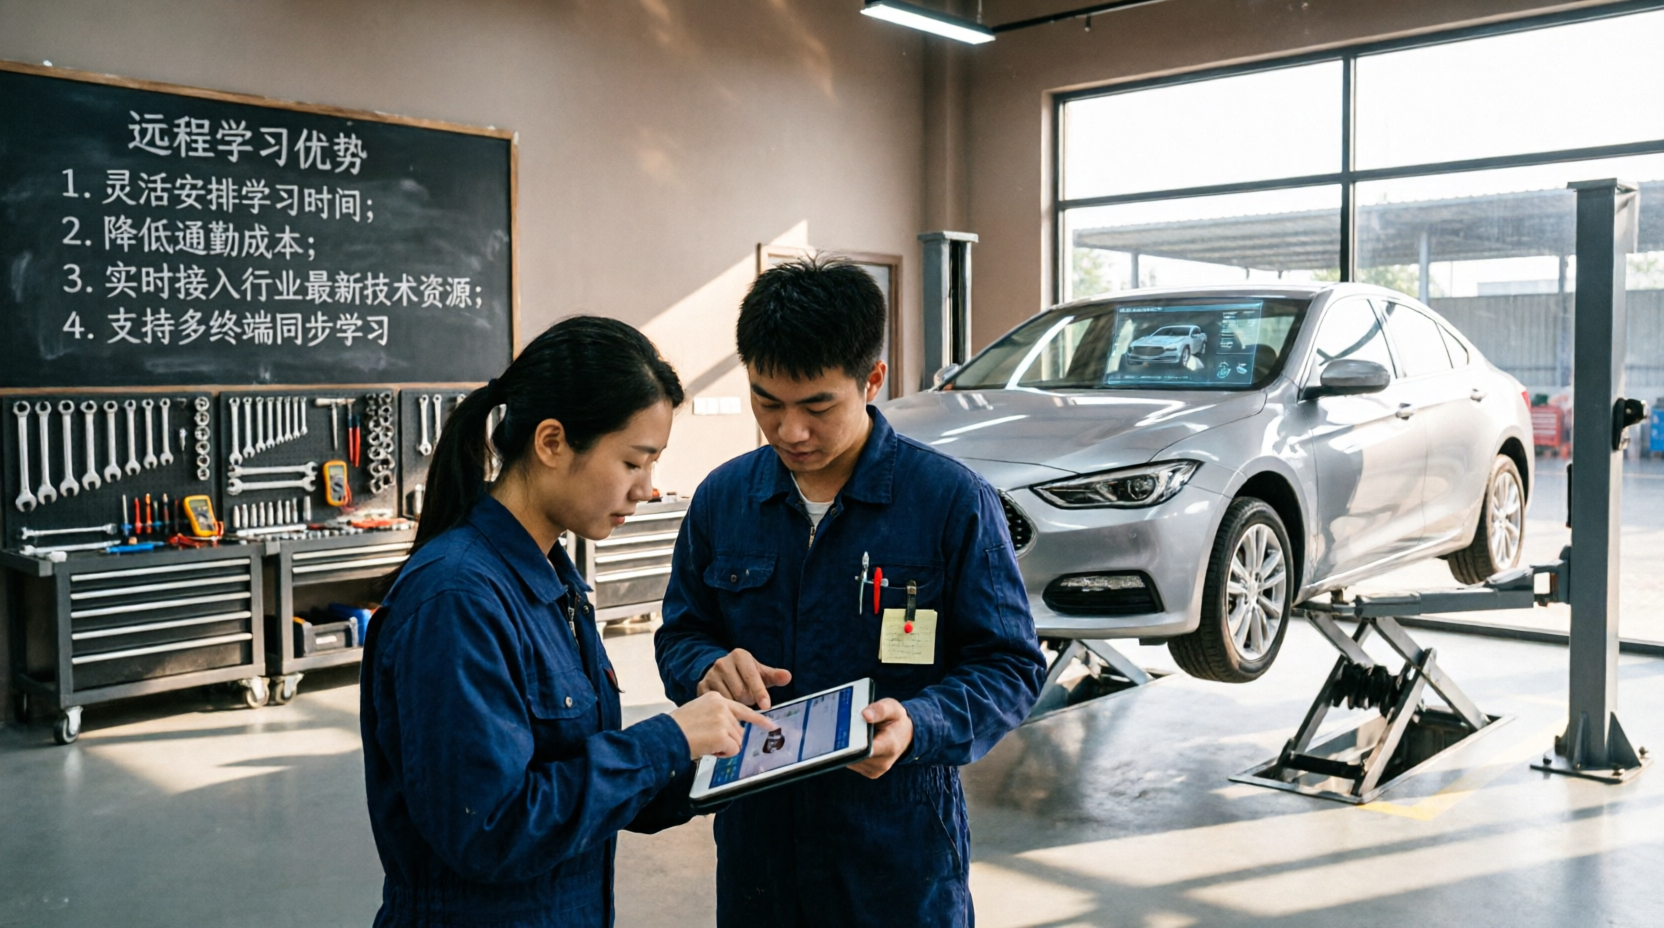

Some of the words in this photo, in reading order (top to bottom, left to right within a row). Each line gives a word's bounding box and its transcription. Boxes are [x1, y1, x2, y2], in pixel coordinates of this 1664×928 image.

[128, 110, 368, 175] 远程学习优势
[62, 168, 91, 199] 1.
[102, 169, 374, 223] 灵活安排学习时间；
[62, 216, 92, 246] 2.
[104, 214, 315, 261] 降低通勤成本；
[63, 263, 93, 293] 3.
[105, 260, 483, 309] 实时接入行业最新技术资源；
[62, 311, 94, 340] 4.
[106, 306, 389, 347] 支持多终端同步学习
